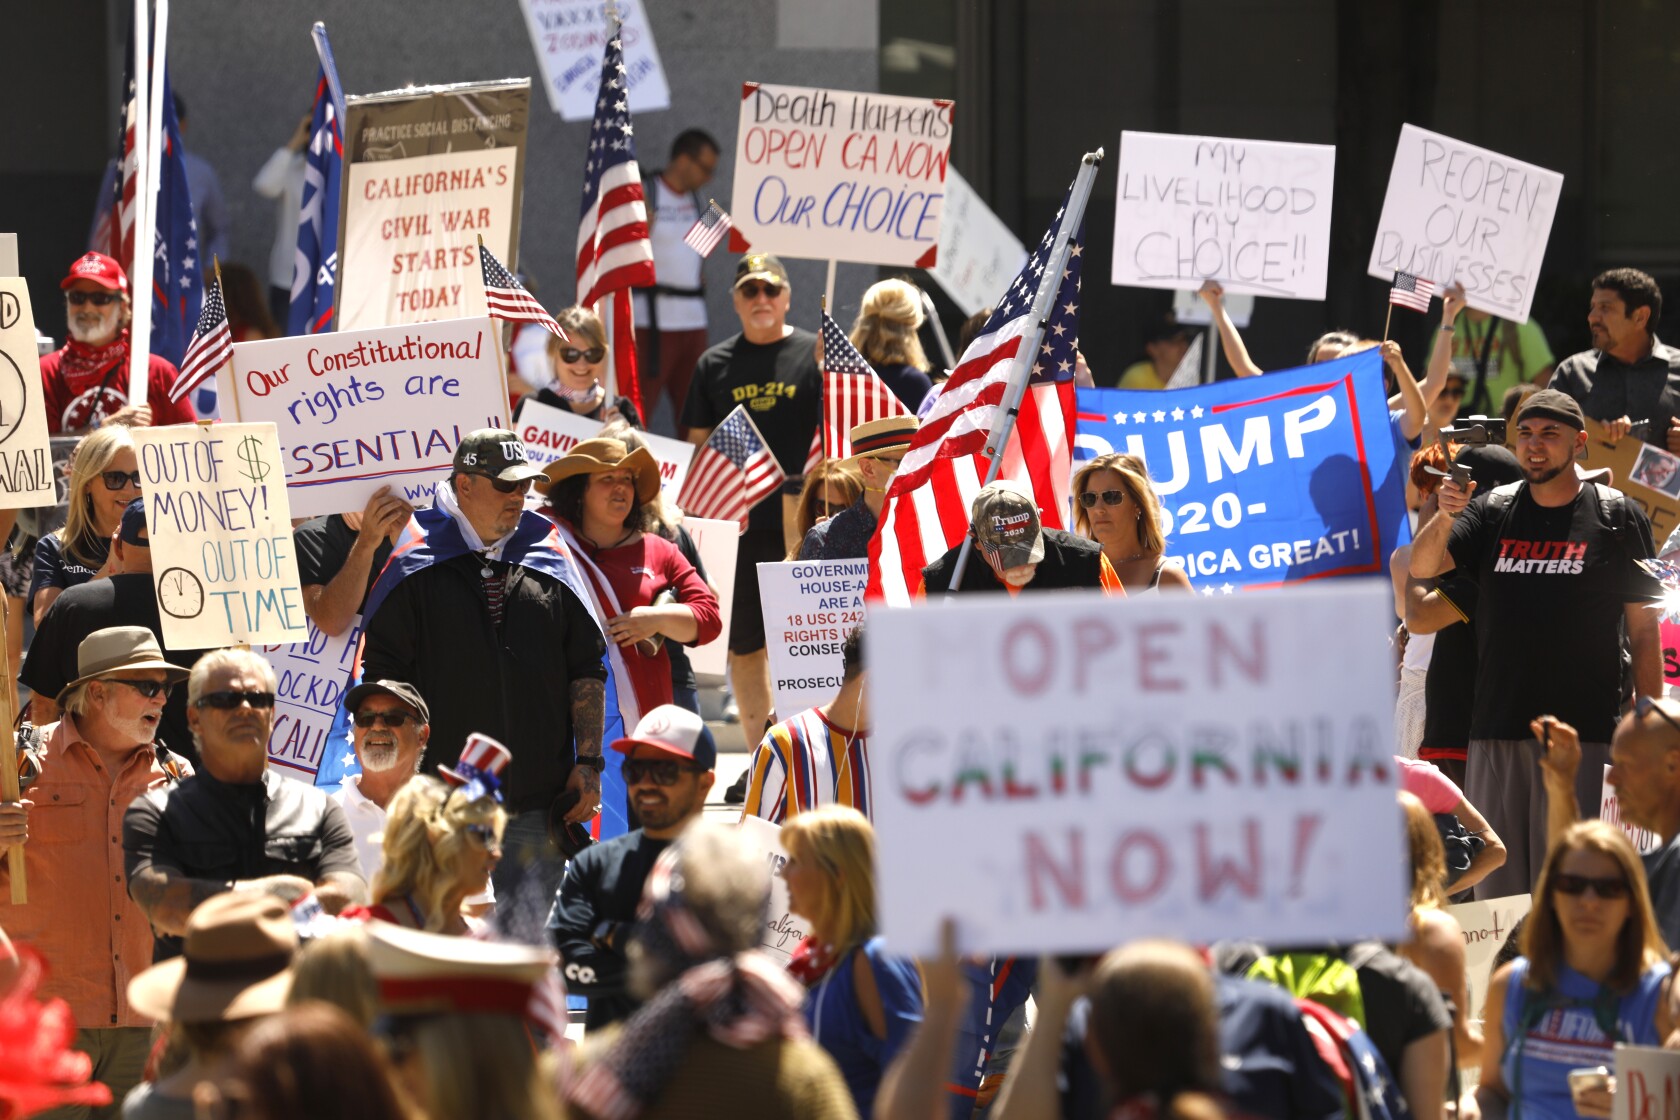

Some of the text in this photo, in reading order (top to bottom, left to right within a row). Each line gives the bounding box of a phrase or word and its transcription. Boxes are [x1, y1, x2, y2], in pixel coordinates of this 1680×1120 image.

[754, 88, 950, 140] Death Happens
[361, 123, 413, 143] PRACTICE
[414, 120, 449, 137] SOCIAL
[841, 132, 877, 173] CA
[886, 138, 950, 183] NOW
[1194, 141, 1246, 174] MY
[364, 164, 508, 201] CALIFORNIA'S
[1122, 172, 1317, 216] LIVELIHOOD
[1420, 137, 1541, 223] REOPEN
[381, 207, 491, 241] CIVIL WAR
[1191, 209, 1240, 239] MY
[1425, 203, 1500, 264] OUR
[391, 245, 475, 275] STARTS
[396, 284, 462, 313] TODAY
[246, 331, 483, 397] Our Constitutional
[287, 374, 461, 425] rights are
[732, 381, 797, 403] DD-214
[463, 453, 477, 466] 45
[152, 485, 270, 535] MONEY!
[992, 512, 1030, 527] Trump
[1004, 527, 1025, 537] 2020
[1248, 528, 1360, 569] GREAT!
[1499, 538, 1588, 560] TRUTH
[202, 537, 288, 583] OUT OF
[792, 563, 870, 579] GOVERNM
[1493, 557, 1585, 575] MATTERS
[209, 587, 306, 634] TIME
[787, 610, 865, 626] 18 USC 242
[818, 597, 849, 609] ARE
[784, 629, 838, 643] RIGHTS
[1001, 616, 1272, 698] OPEN
[893, 715, 1394, 806] CALIFORNIA
[1021, 814, 1325, 913] NOW!
